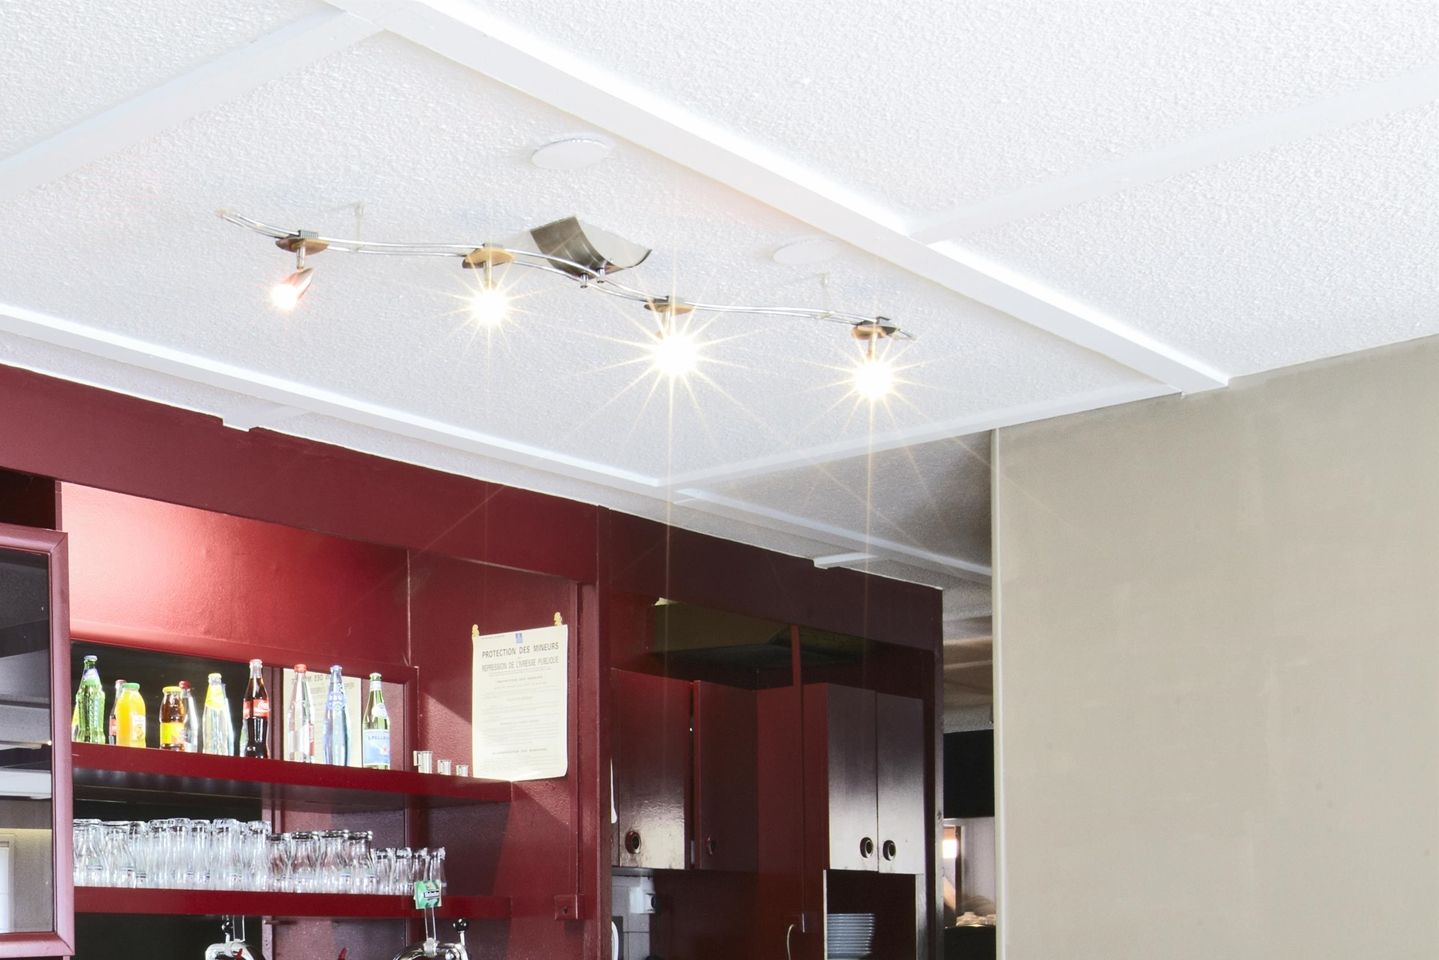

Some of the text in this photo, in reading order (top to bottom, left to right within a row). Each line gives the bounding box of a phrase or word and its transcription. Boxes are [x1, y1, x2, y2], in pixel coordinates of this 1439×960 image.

[482, 642, 559, 659] PROTECTION DES MINEURS
